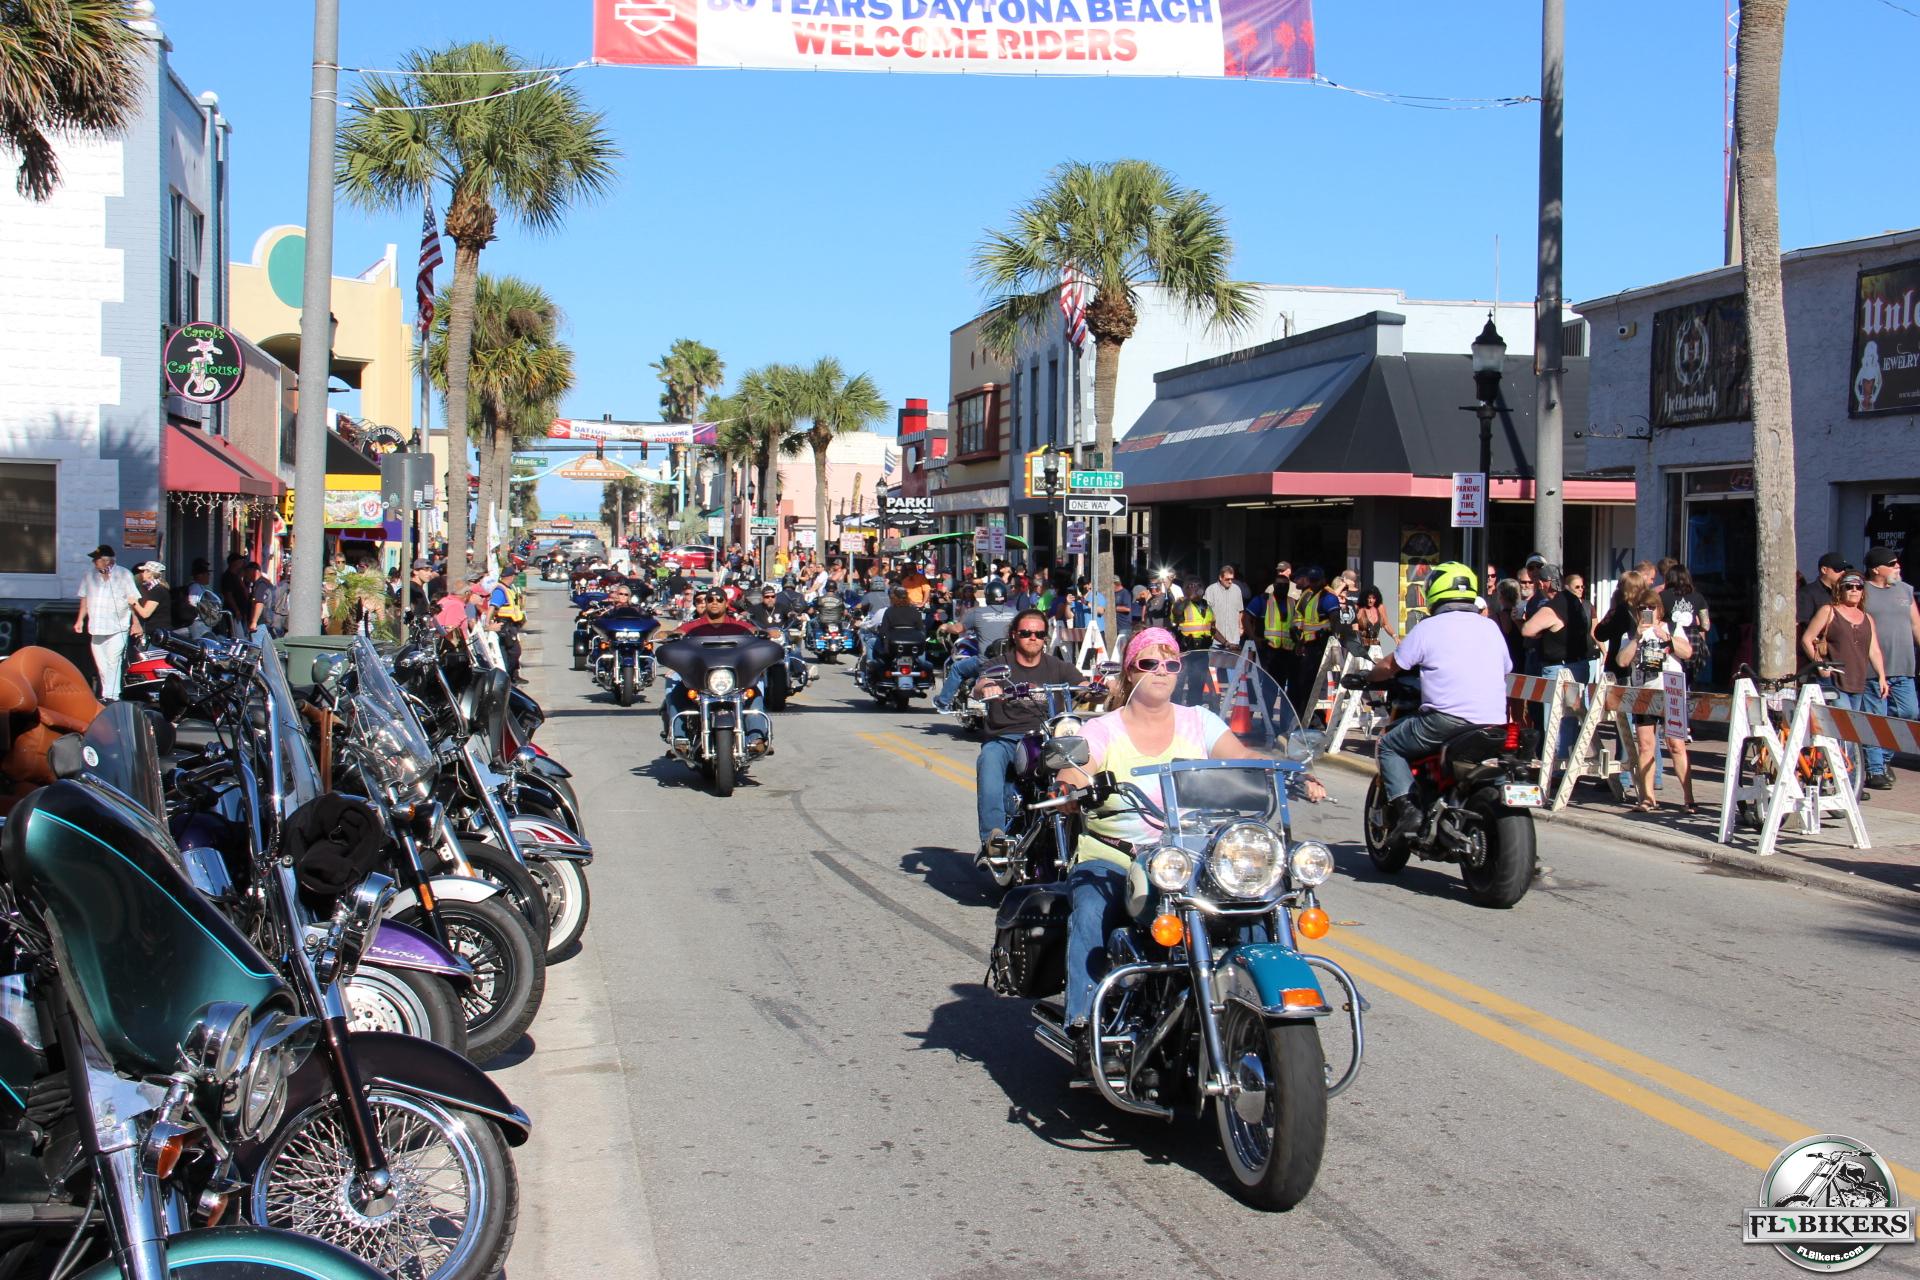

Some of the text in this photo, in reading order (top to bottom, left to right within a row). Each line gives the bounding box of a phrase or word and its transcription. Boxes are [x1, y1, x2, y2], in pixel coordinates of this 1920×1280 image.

[902, 0, 1082, 24] DAYTONA
[1086, 0, 1214, 24] BEACH
[792, 21, 1138, 61] WELCOME RIDERS
[182, 326, 225, 340] Carol's
[166, 360, 195, 374] Cat
[514, 458, 538, 466] Atlantic
[1077, 473, 1103, 487] Fern
[1464, 477, 1473, 485] NO
[1455, 485, 1480, 493] PARKING
[886, 497, 935, 508] PARKI
[1462, 493, 1474, 501] ANY
[1071, 500, 1109, 511] ONE WAY
[1460, 501, 1475, 509] TIME
[1876, 531, 1905, 540] SUPPORT
